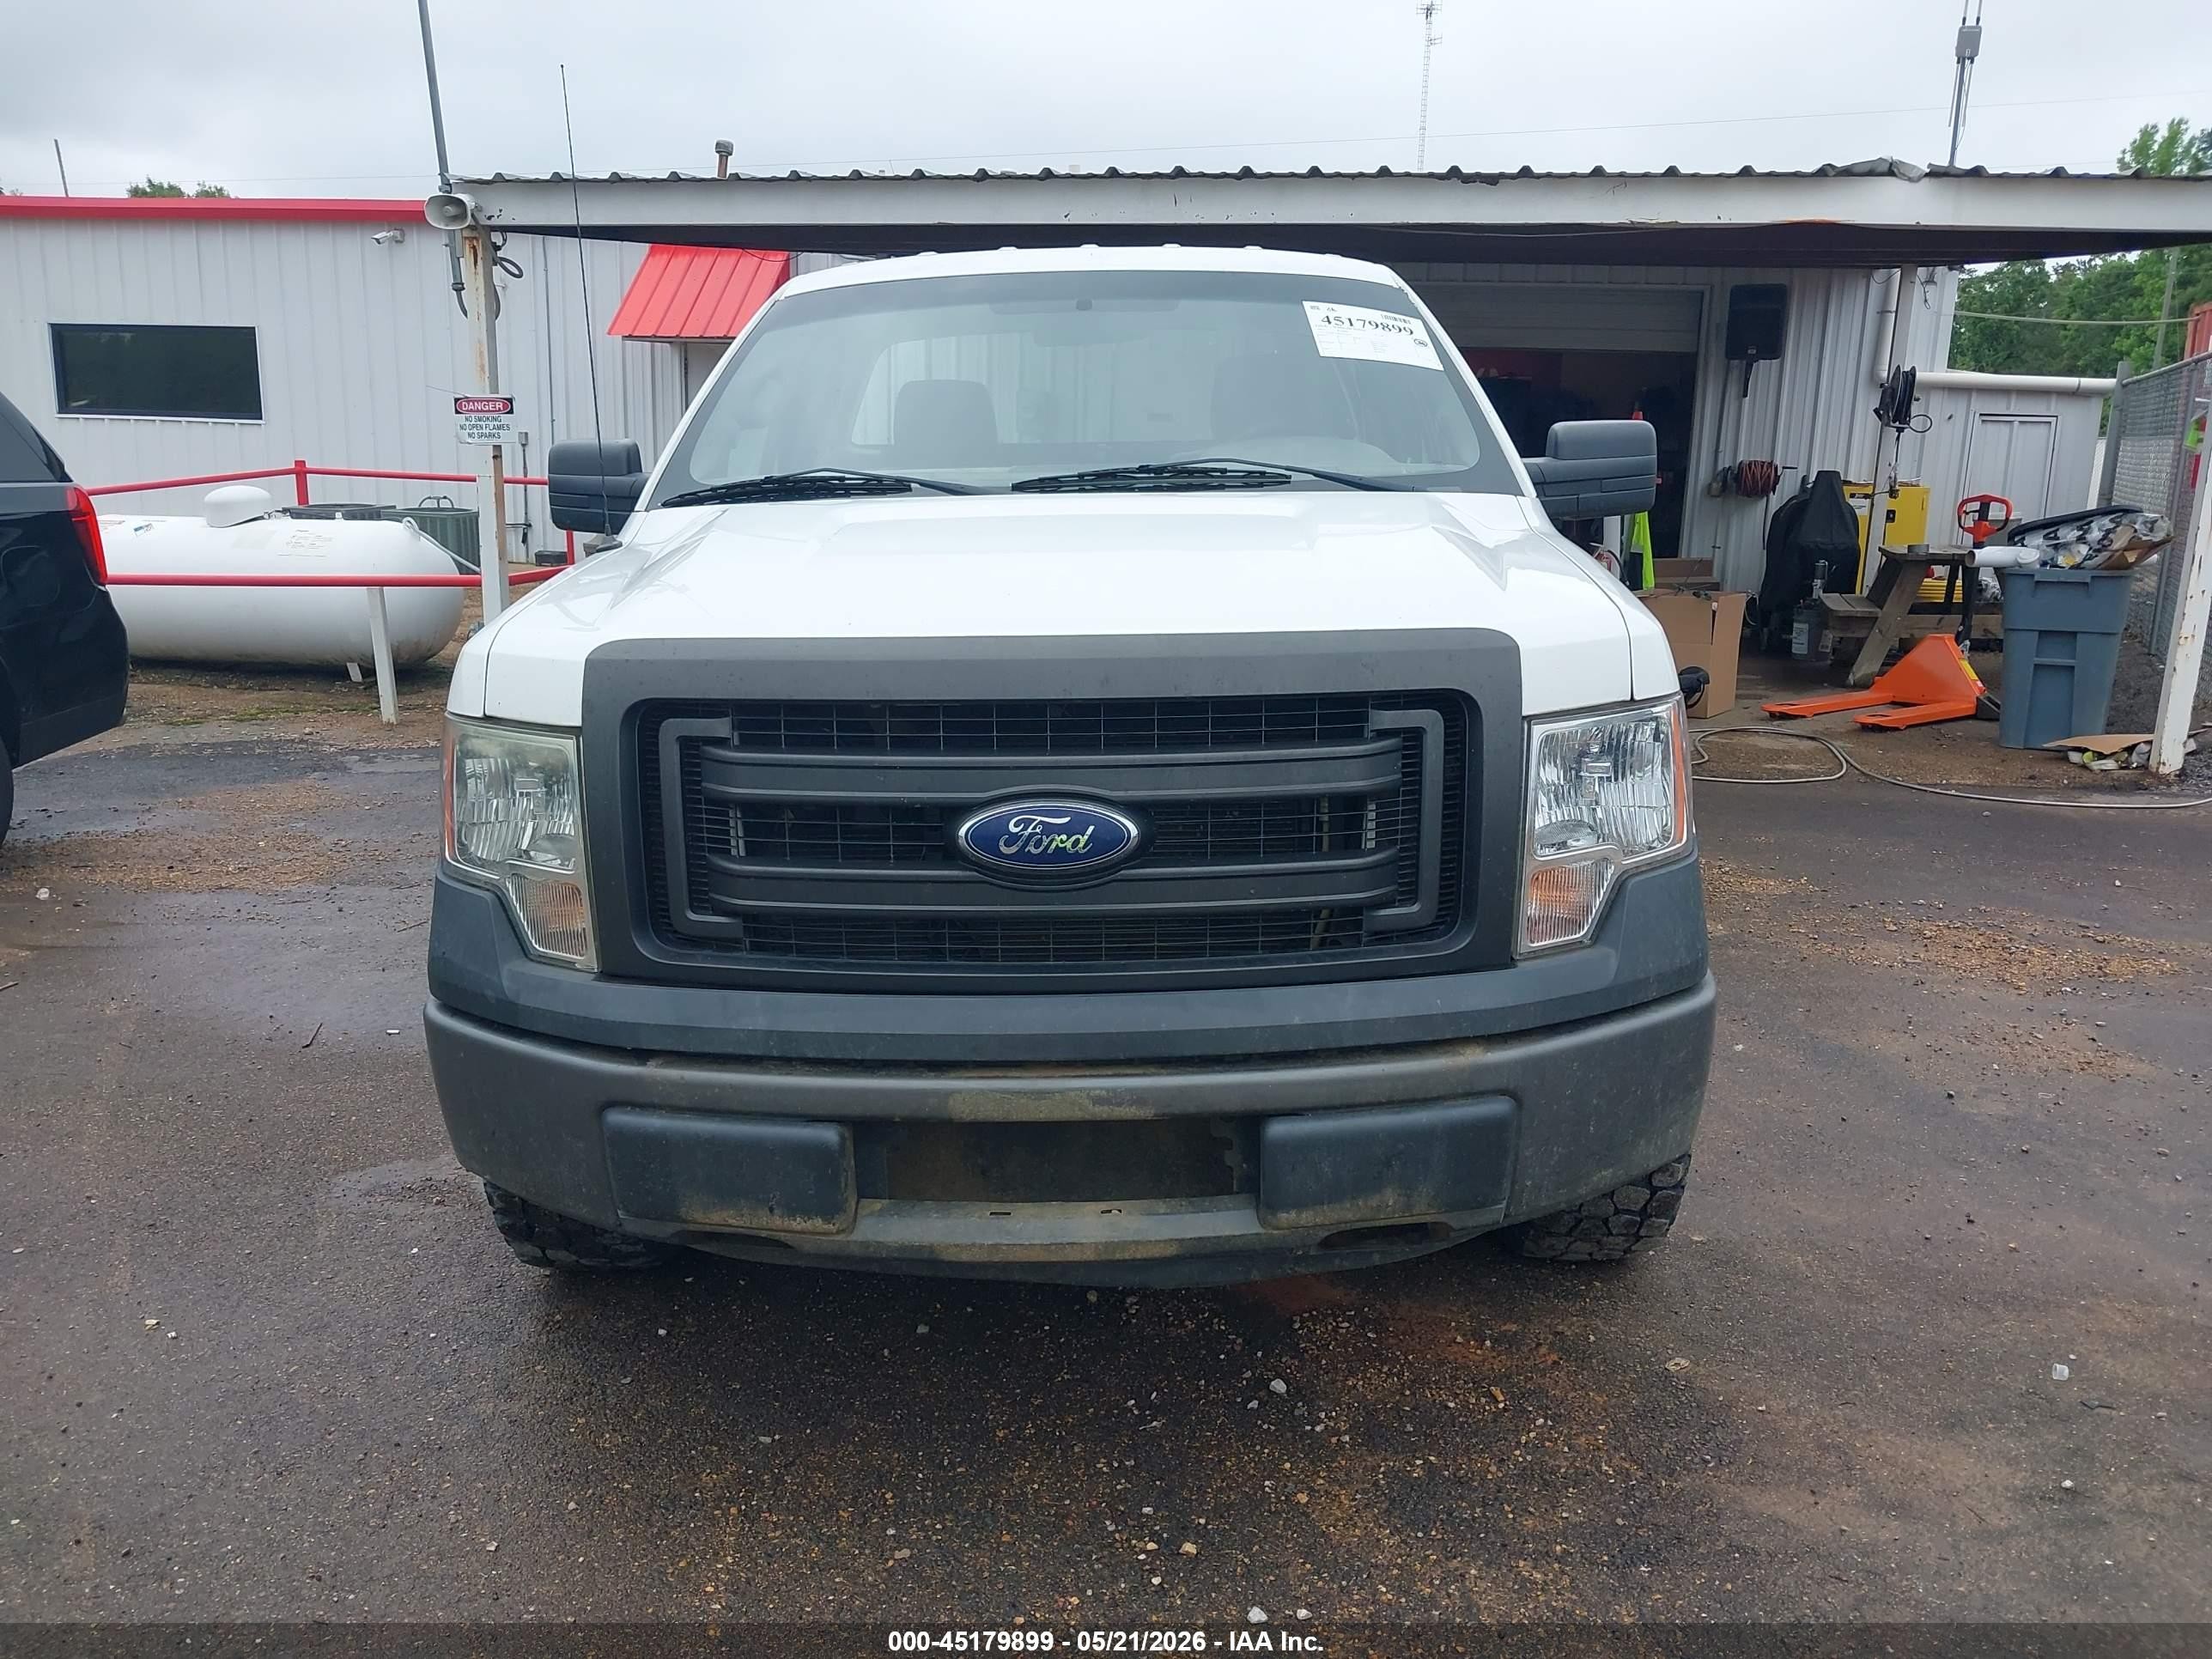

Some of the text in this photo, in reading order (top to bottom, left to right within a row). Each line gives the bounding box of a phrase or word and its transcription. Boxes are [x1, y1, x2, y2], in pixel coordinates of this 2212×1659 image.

[1321, 315, 1414, 336] 45179899
[462, 401, 503, 411] DANGER
[999, 815, 1096, 854] Ford
